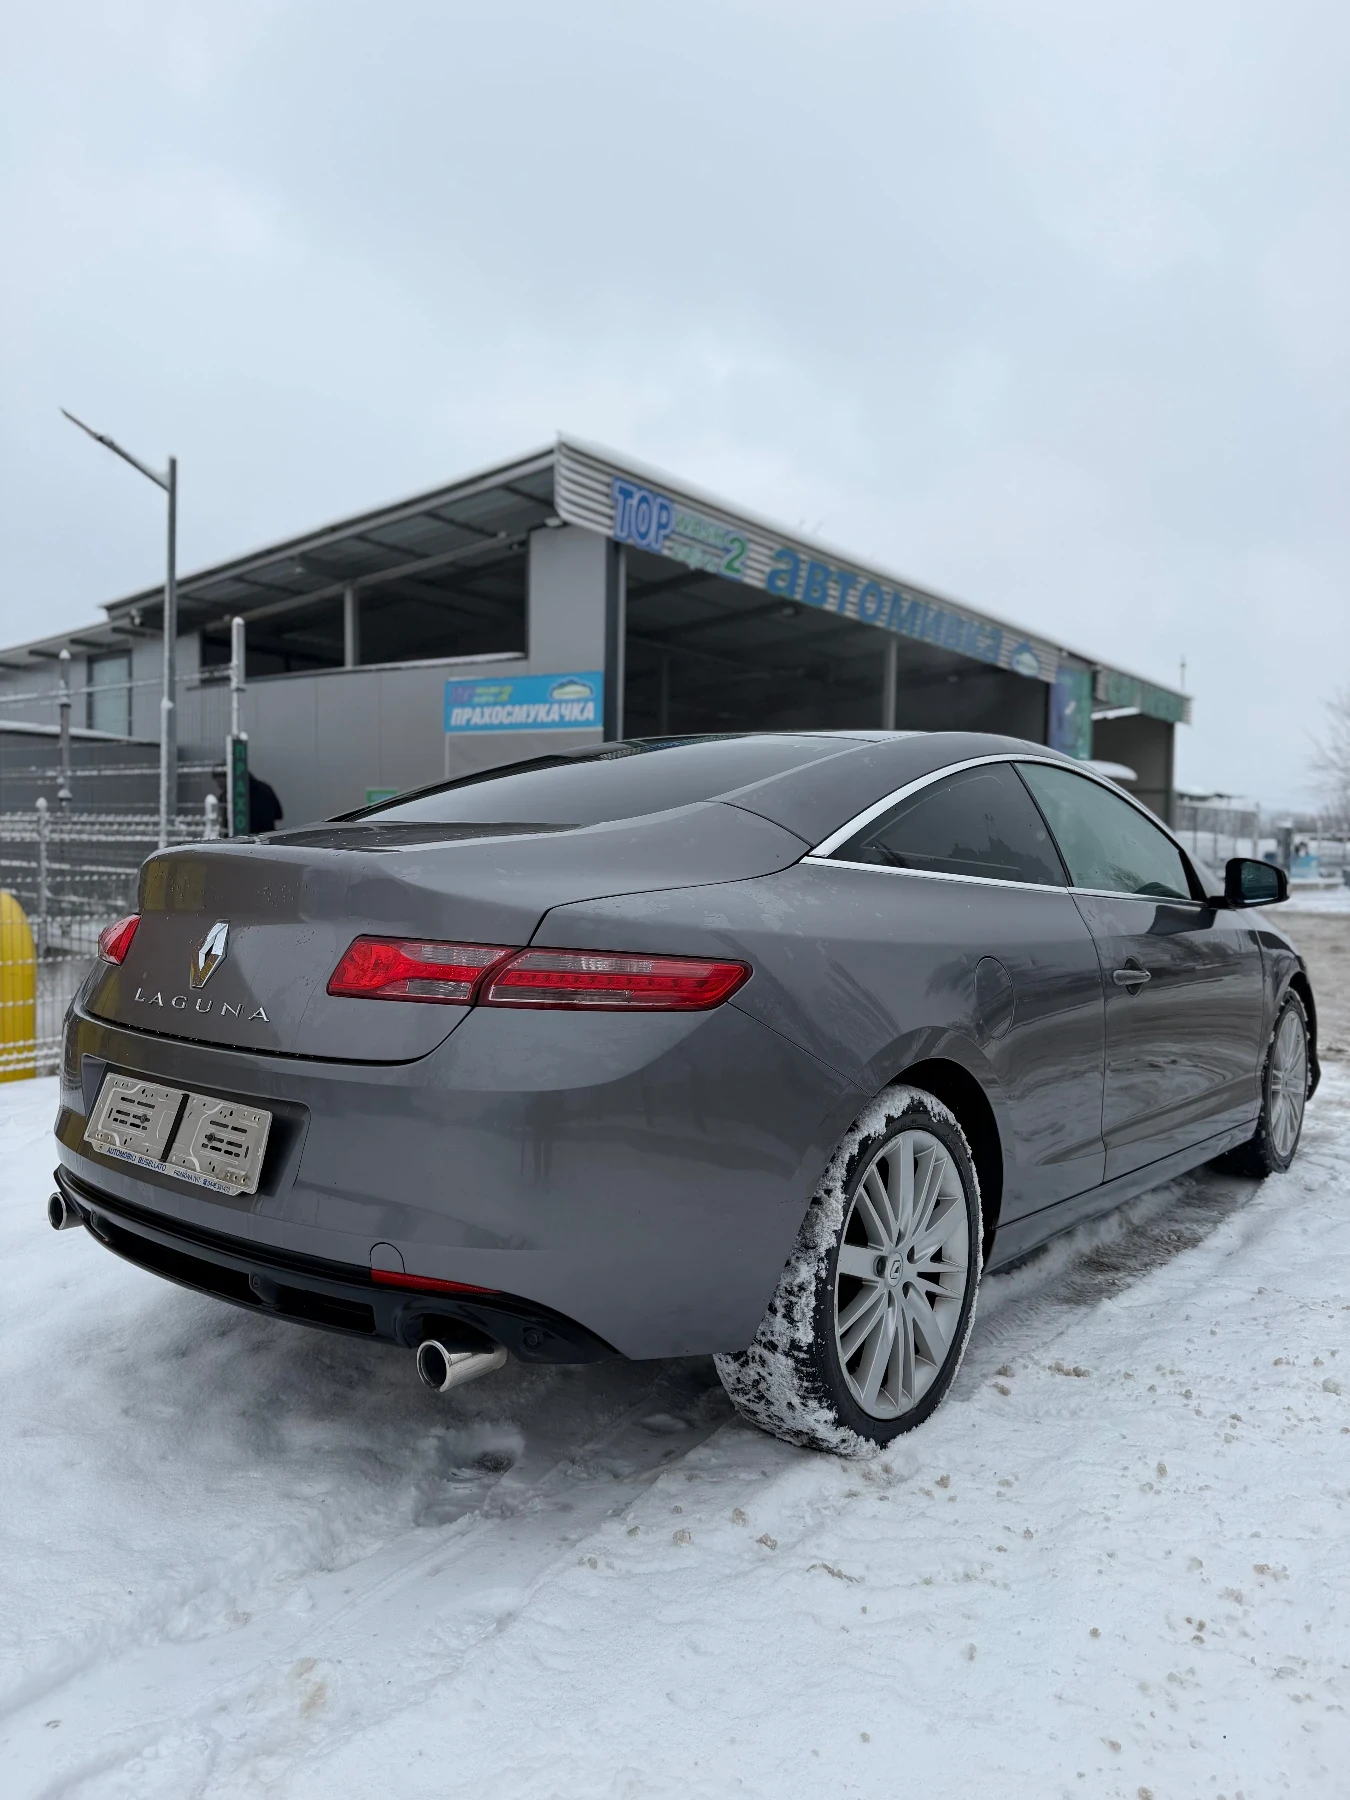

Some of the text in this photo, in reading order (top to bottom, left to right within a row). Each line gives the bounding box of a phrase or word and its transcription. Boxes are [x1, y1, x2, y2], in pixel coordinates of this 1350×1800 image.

[613, 479, 674, 551] TOP
[720, 532, 748, 577] 2
[451, 701, 595, 726] ПРАХОСМУКАЧКА
[134, 987, 270, 1022] LAGUNA
